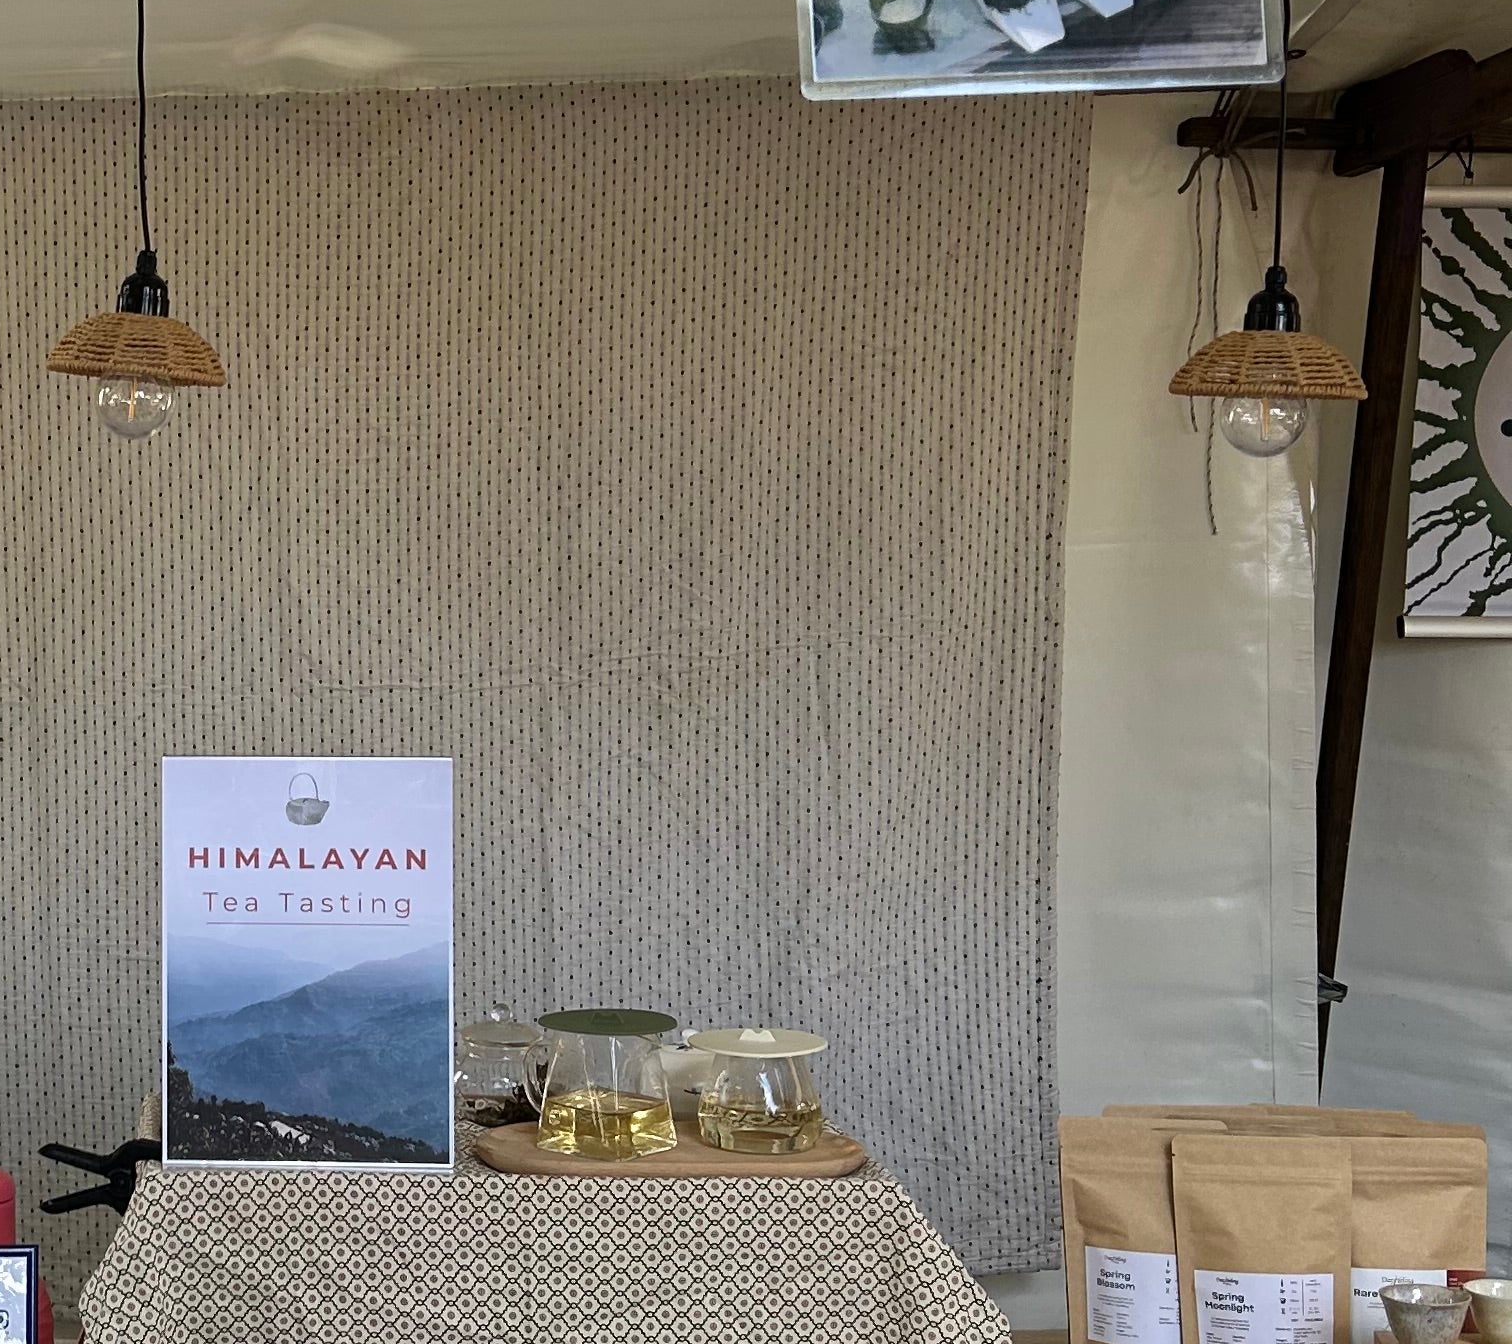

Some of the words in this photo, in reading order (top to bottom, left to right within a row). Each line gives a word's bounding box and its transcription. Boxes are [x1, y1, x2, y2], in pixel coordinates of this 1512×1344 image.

[188, 847, 428, 871] HIMALAYAN
[203, 891, 259, 913] Tea
[278, 892, 413, 919] Tasting
[1100, 1268, 1131, 1281] Spring
[1211, 1291, 1245, 1304] Spring
[1353, 1287, 1379, 1298] Rare
[1204, 1301, 1255, 1314] Moonlight
